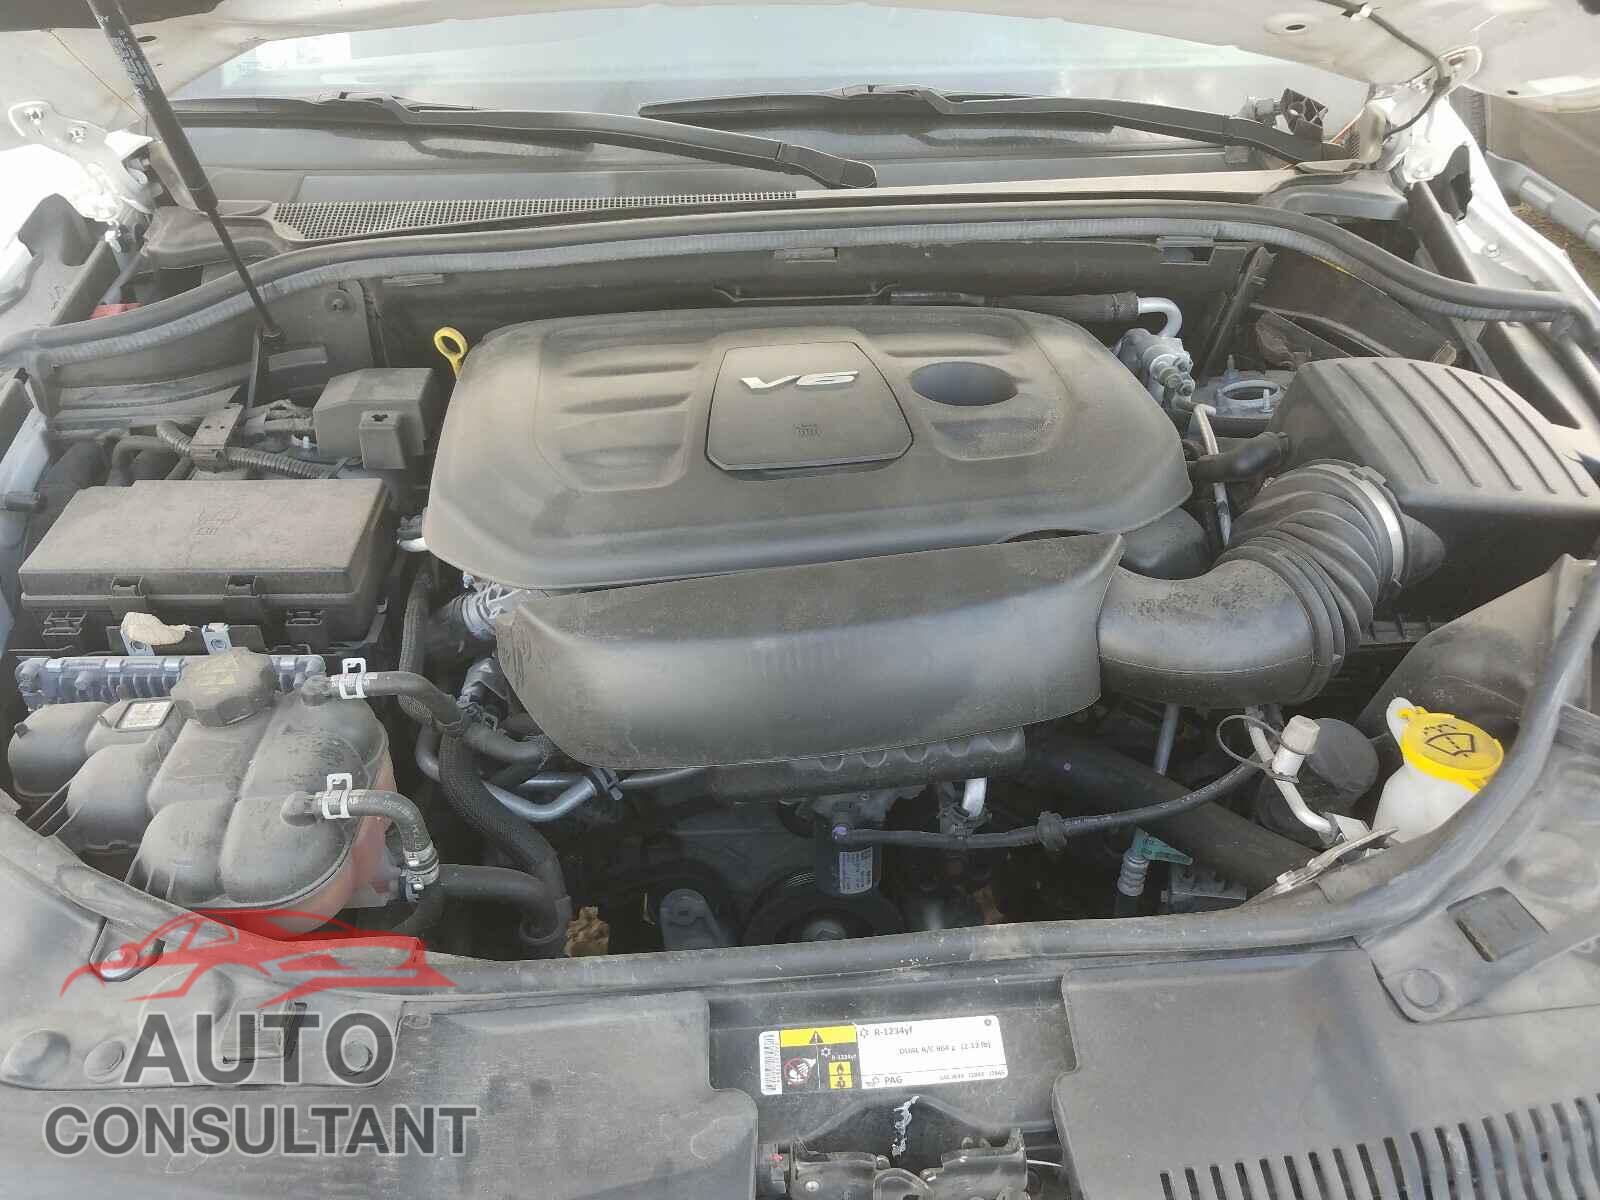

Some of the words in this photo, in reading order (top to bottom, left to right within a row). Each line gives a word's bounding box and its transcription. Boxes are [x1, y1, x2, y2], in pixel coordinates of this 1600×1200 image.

[740, 370, 859, 389] V6
[874, 1026, 913, 1037] R-1234yf
[899, 1047, 919, 1055] DUAL
[884, 1075, 903, 1085] PAG
